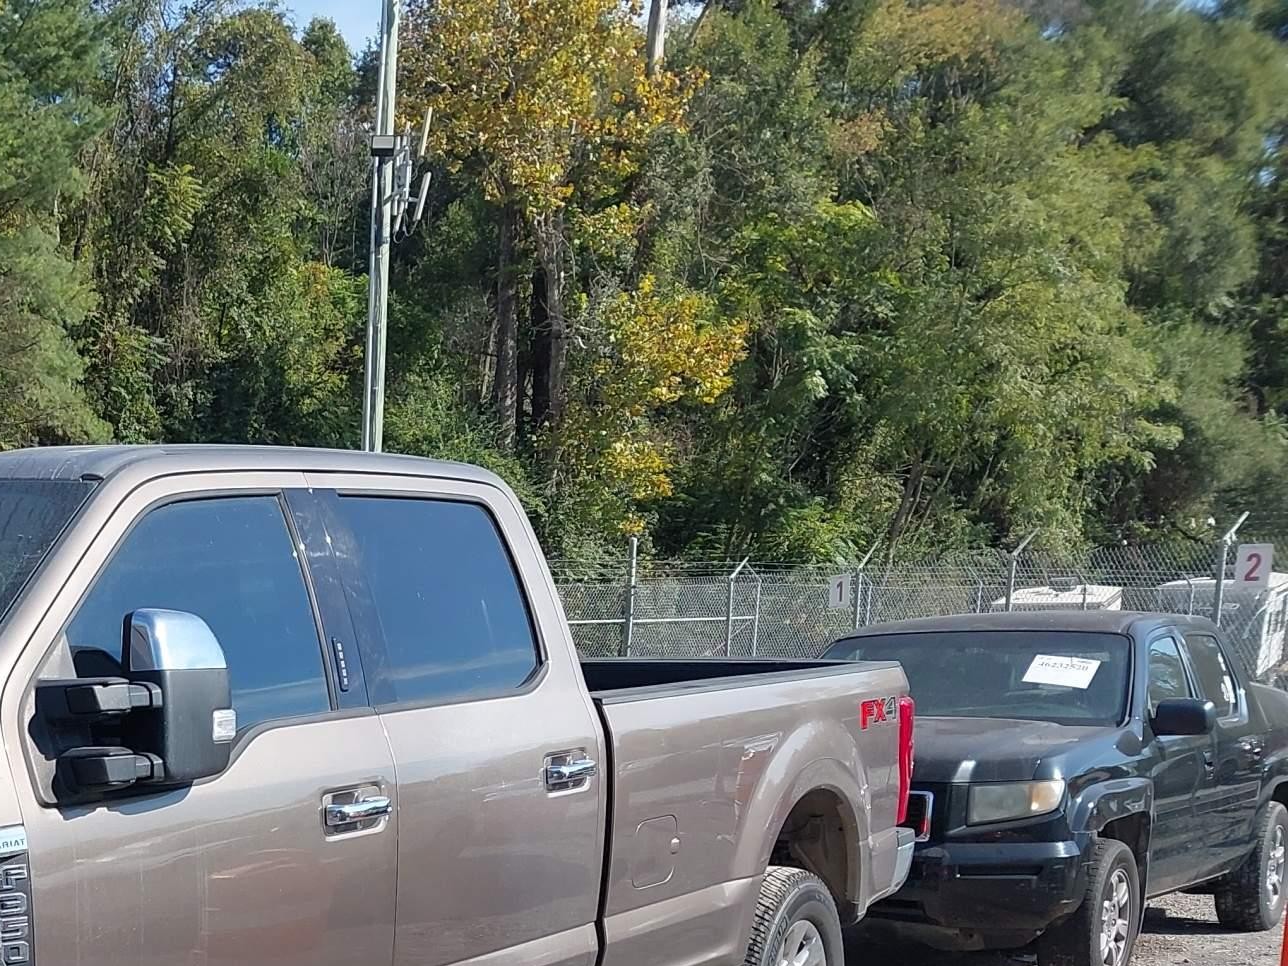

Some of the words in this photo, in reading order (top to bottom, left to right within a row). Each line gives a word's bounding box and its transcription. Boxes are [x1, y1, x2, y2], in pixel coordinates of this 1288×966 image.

[1244, 552, 1262, 581] 2
[836, 580, 844, 602] 1
[860, 696, 897, 731] FX4
